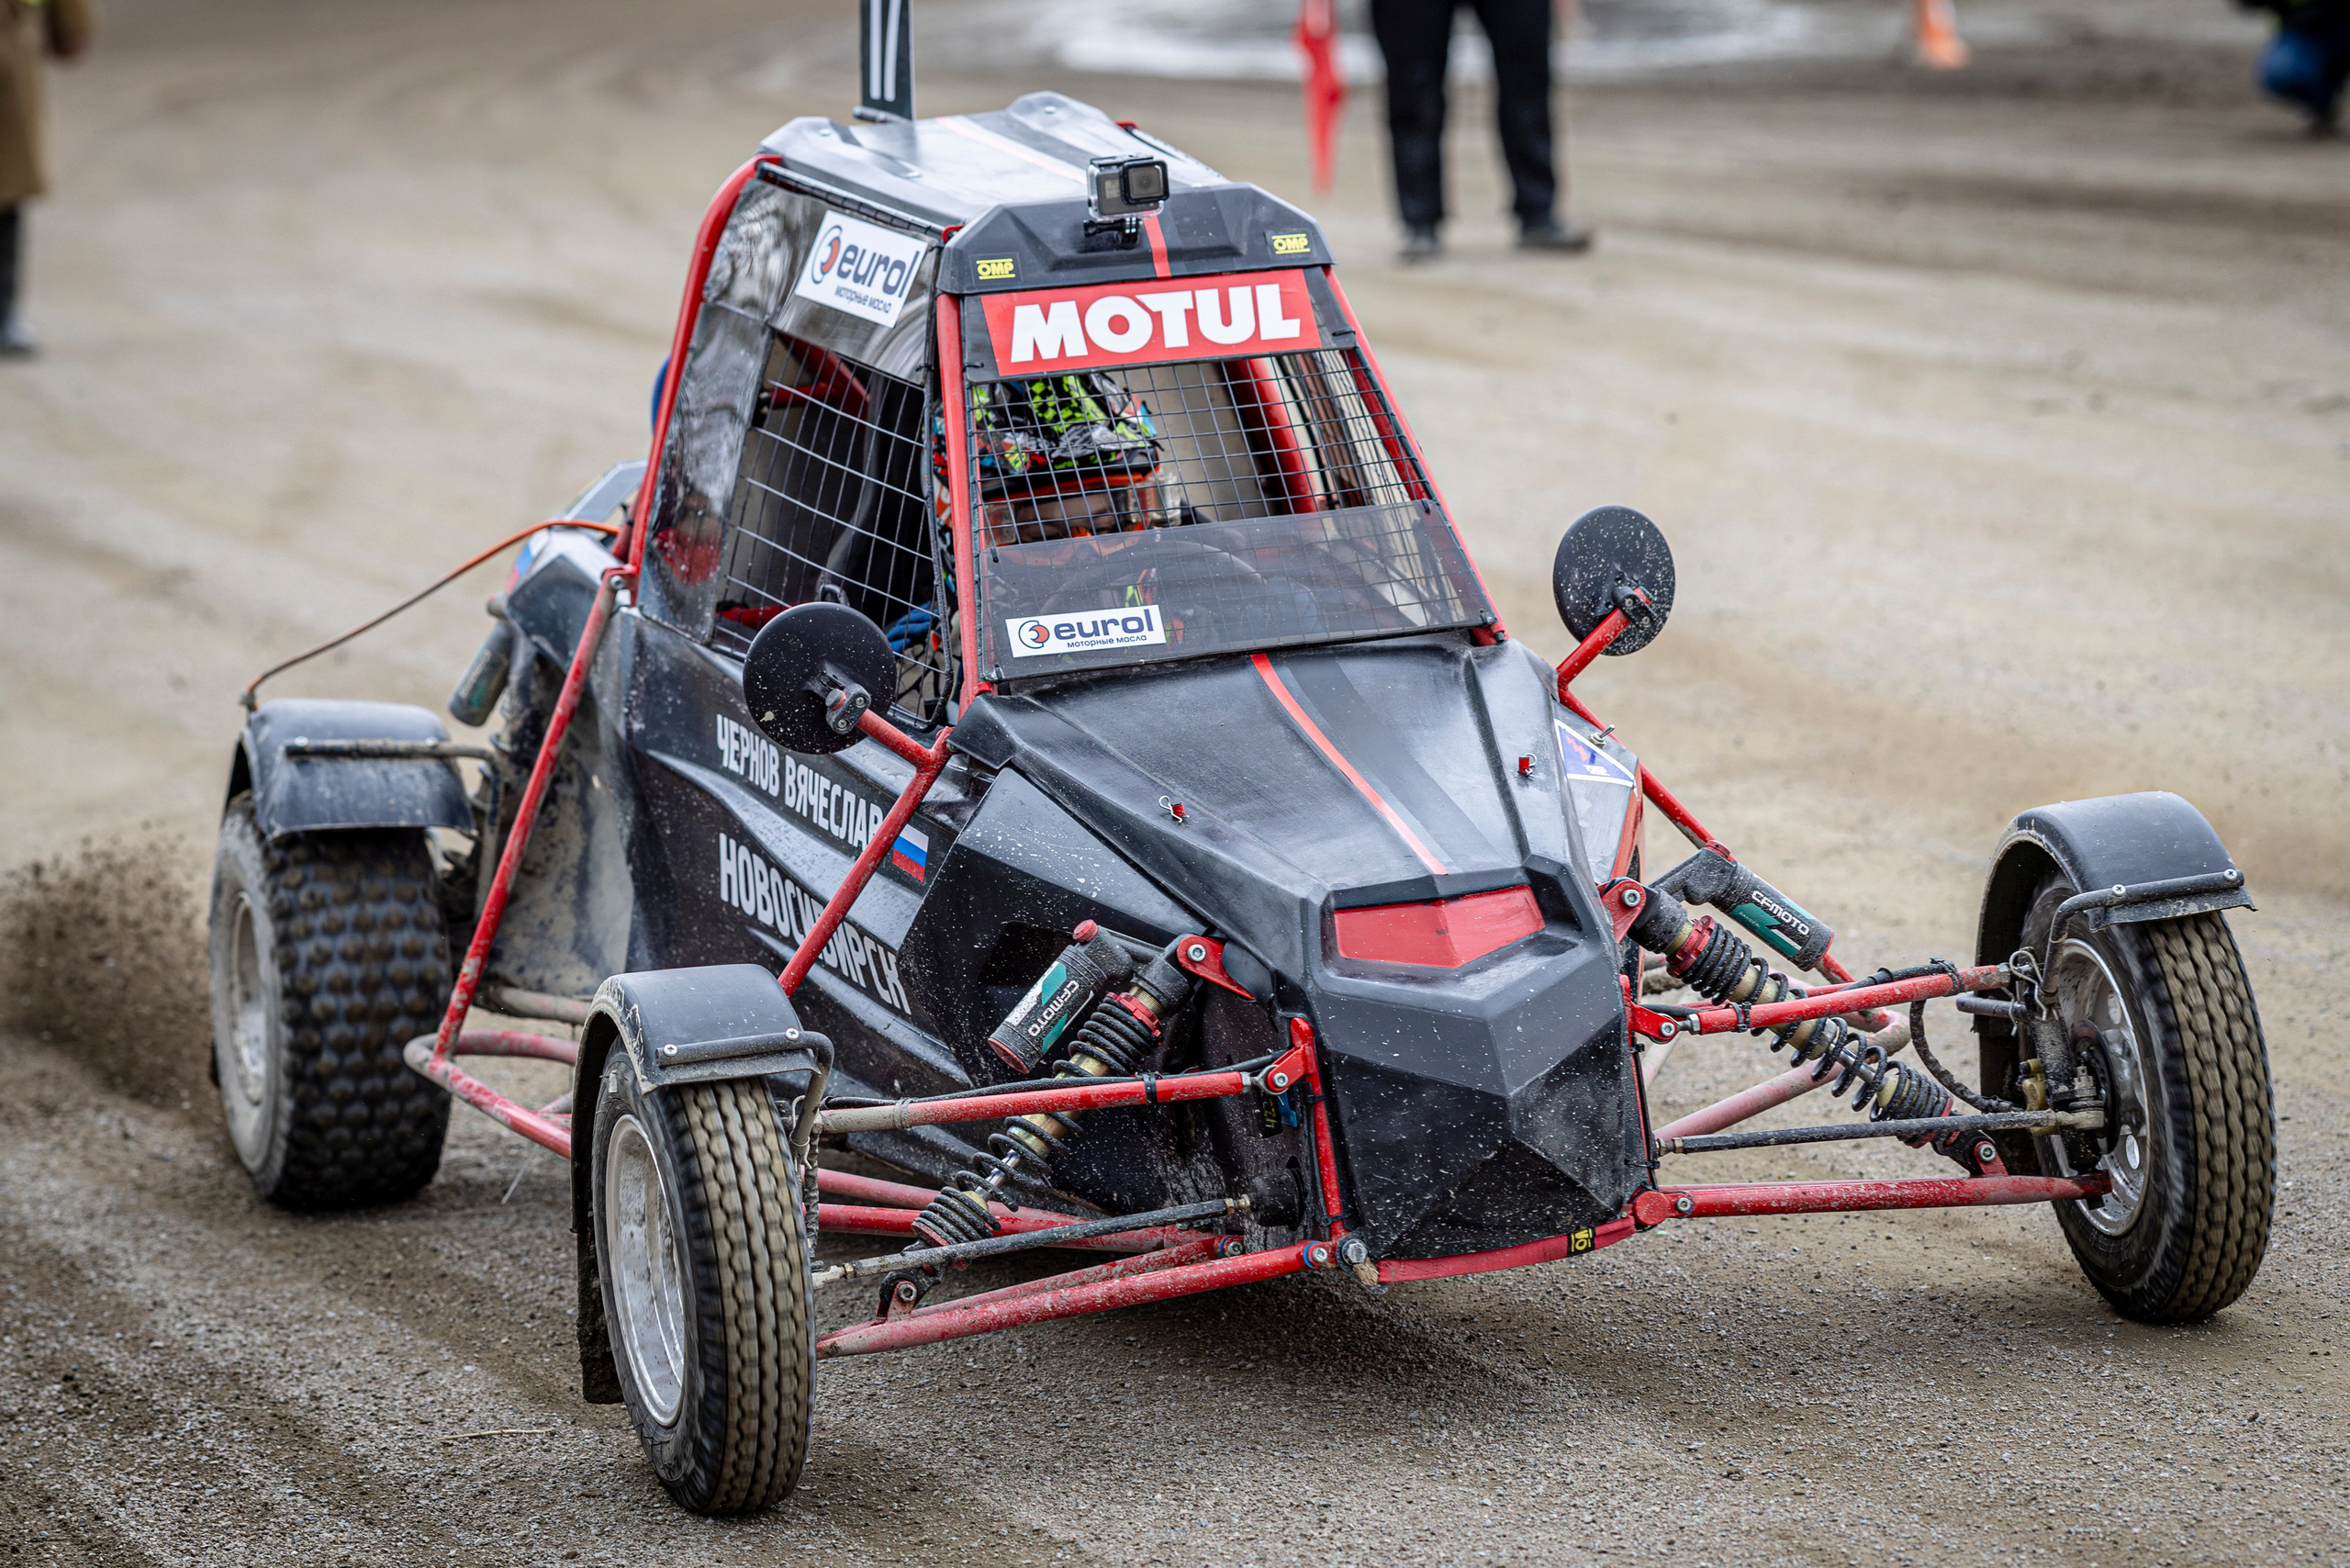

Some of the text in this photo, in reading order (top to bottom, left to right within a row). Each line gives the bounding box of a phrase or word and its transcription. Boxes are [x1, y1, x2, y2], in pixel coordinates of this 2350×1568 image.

[1273, 236, 1309, 252] OMP
[837, 244, 921, 298] eurol
[977, 262, 1014, 276] OMP
[1011, 283, 1301, 363] MOTUL
[1054, 609, 1154, 641] eurol
[1068, 634, 1147, 649] моторные масла
[716, 713, 780, 798] ЧЕРНОВ
[1751, 890, 1810, 935] CFMOTO
[1027, 980, 1080, 1037] CFMOTO
